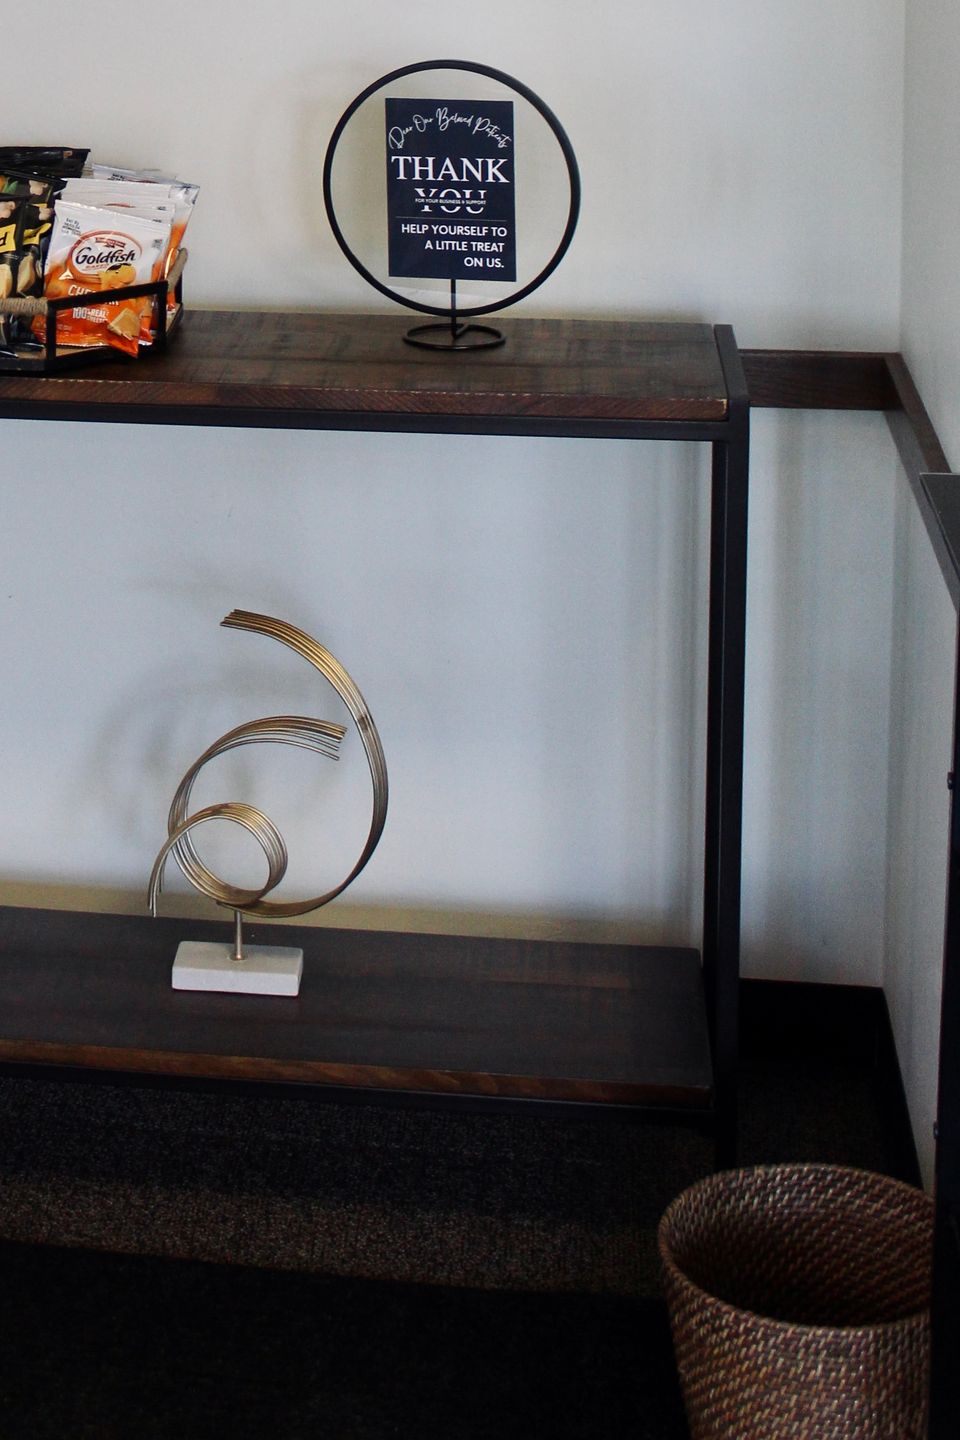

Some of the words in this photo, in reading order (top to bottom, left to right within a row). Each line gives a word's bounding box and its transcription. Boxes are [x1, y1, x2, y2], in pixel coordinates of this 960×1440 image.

[388, 126, 414, 149] Dear
[412, 114, 434, 133] Our
[435, 107, 474, 131] Beloved
[472, 117, 512, 149] Patients
[391, 156, 510, 183] THANK
[414, 187, 487, 214] YOU
[401, 223, 429, 234] HELP
[431, 224, 489, 237] YOURSELF
[491, 226, 508, 237] TO
[75, 246, 137, 266] Goldfish
[424, 240, 434, 250] A
[436, 240, 468, 251] LITTLE
[470, 241, 505, 252] TREAT
[464, 256, 484, 267] ON
[486, 257, 505, 268] US.
